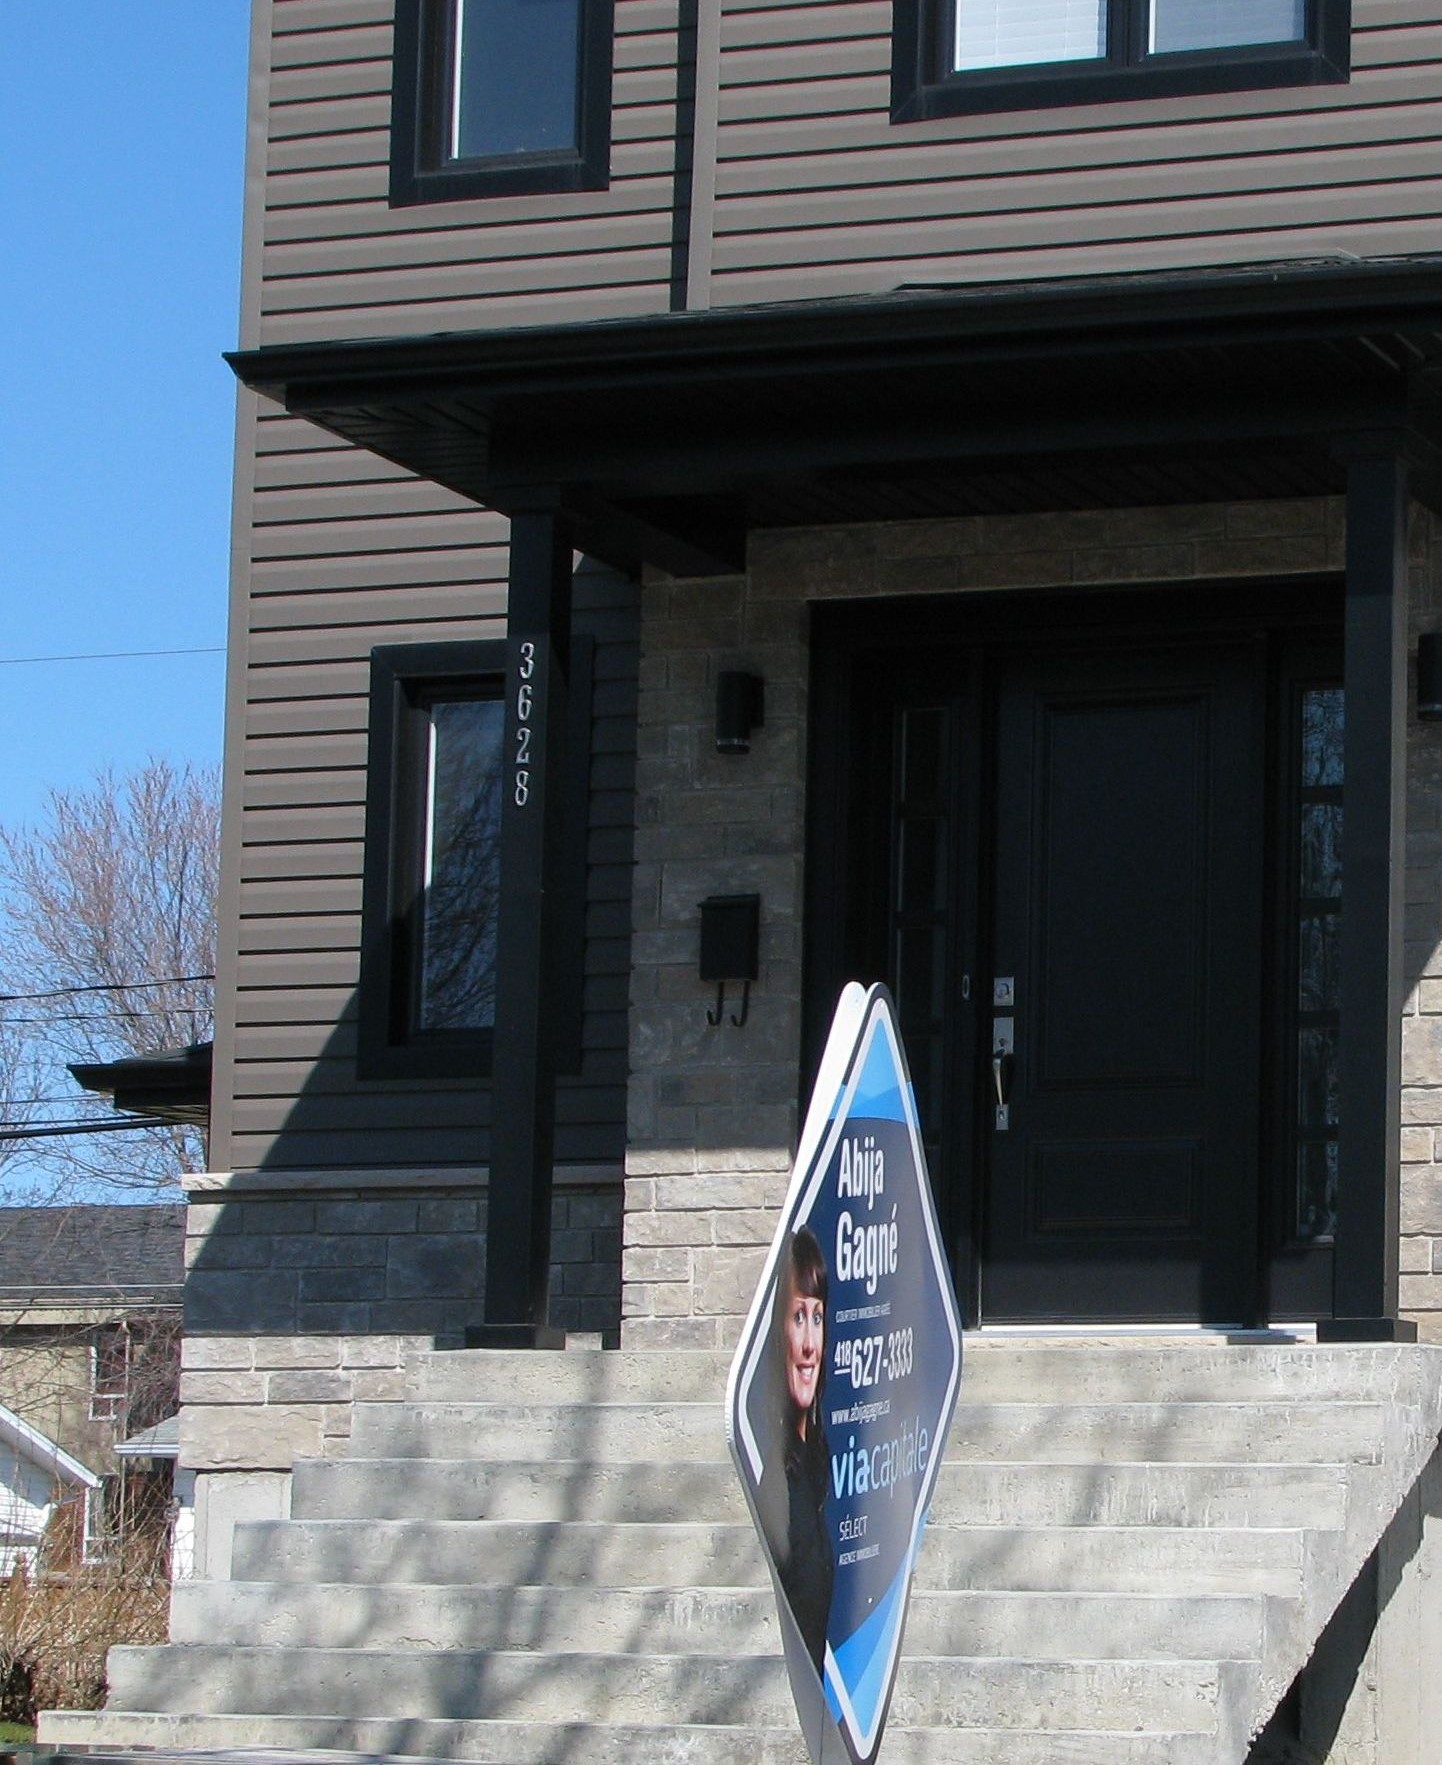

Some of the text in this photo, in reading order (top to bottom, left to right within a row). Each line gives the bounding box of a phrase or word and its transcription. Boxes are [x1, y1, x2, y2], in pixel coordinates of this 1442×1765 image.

[515, 642, 535, 807] 3628
[838, 1137, 884, 1210] Abija
[836, 1204, 898, 1295] Gagné
[839, 1516, 868, 1541] SÉLECT
